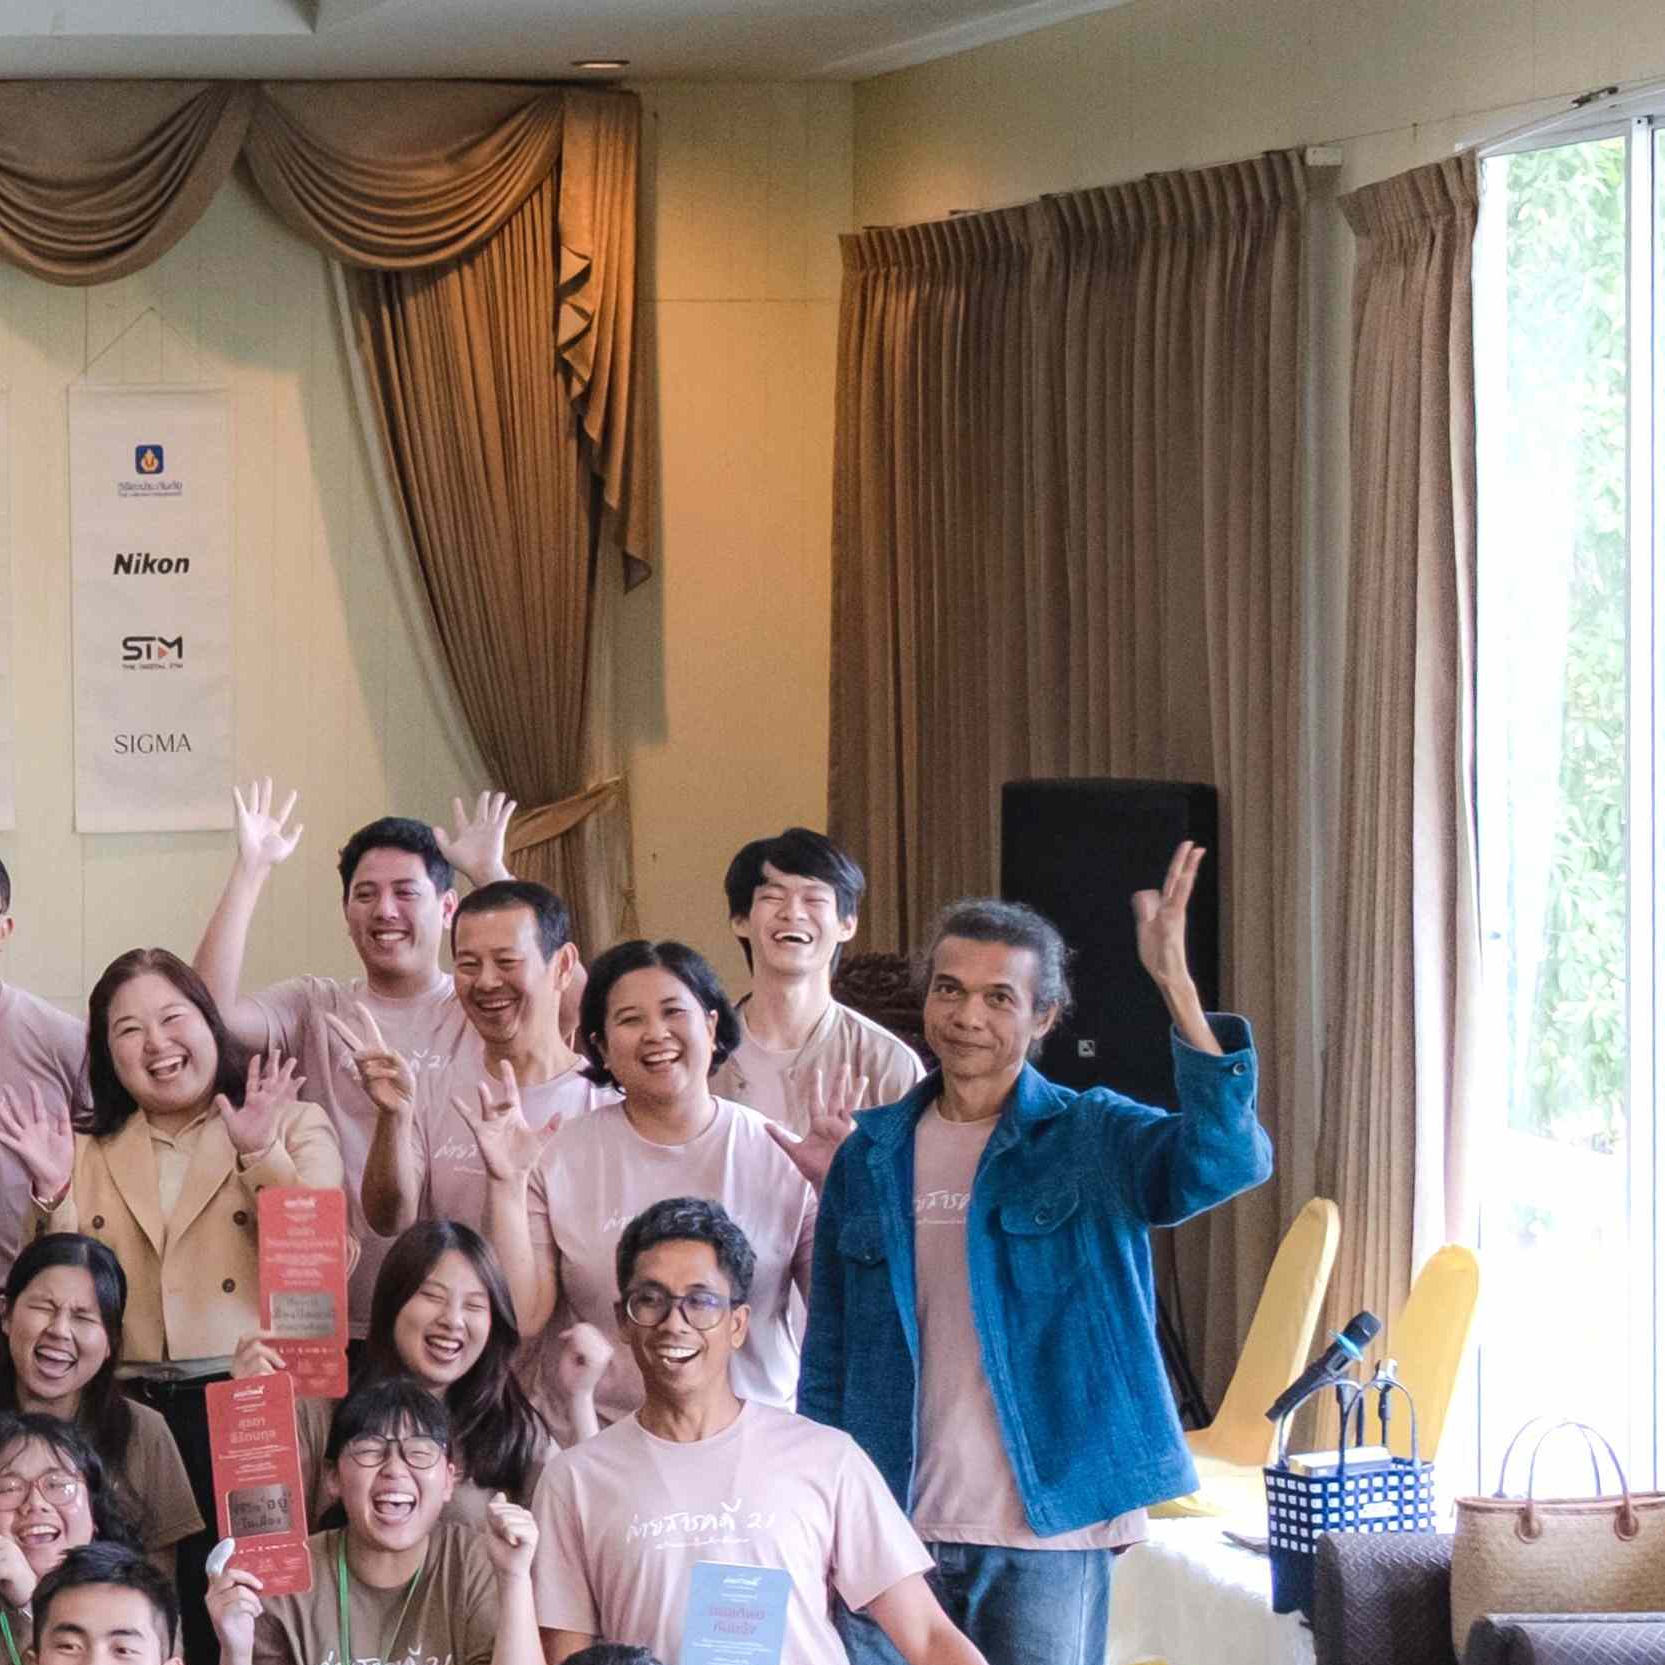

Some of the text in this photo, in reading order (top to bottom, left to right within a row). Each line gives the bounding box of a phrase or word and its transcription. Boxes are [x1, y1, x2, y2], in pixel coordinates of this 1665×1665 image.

[113, 553, 190, 576] Nikon
[122, 636, 184, 662] STM
[113, 734, 192, 755] SIGMA
[747, 1510, 777, 1531] 21
